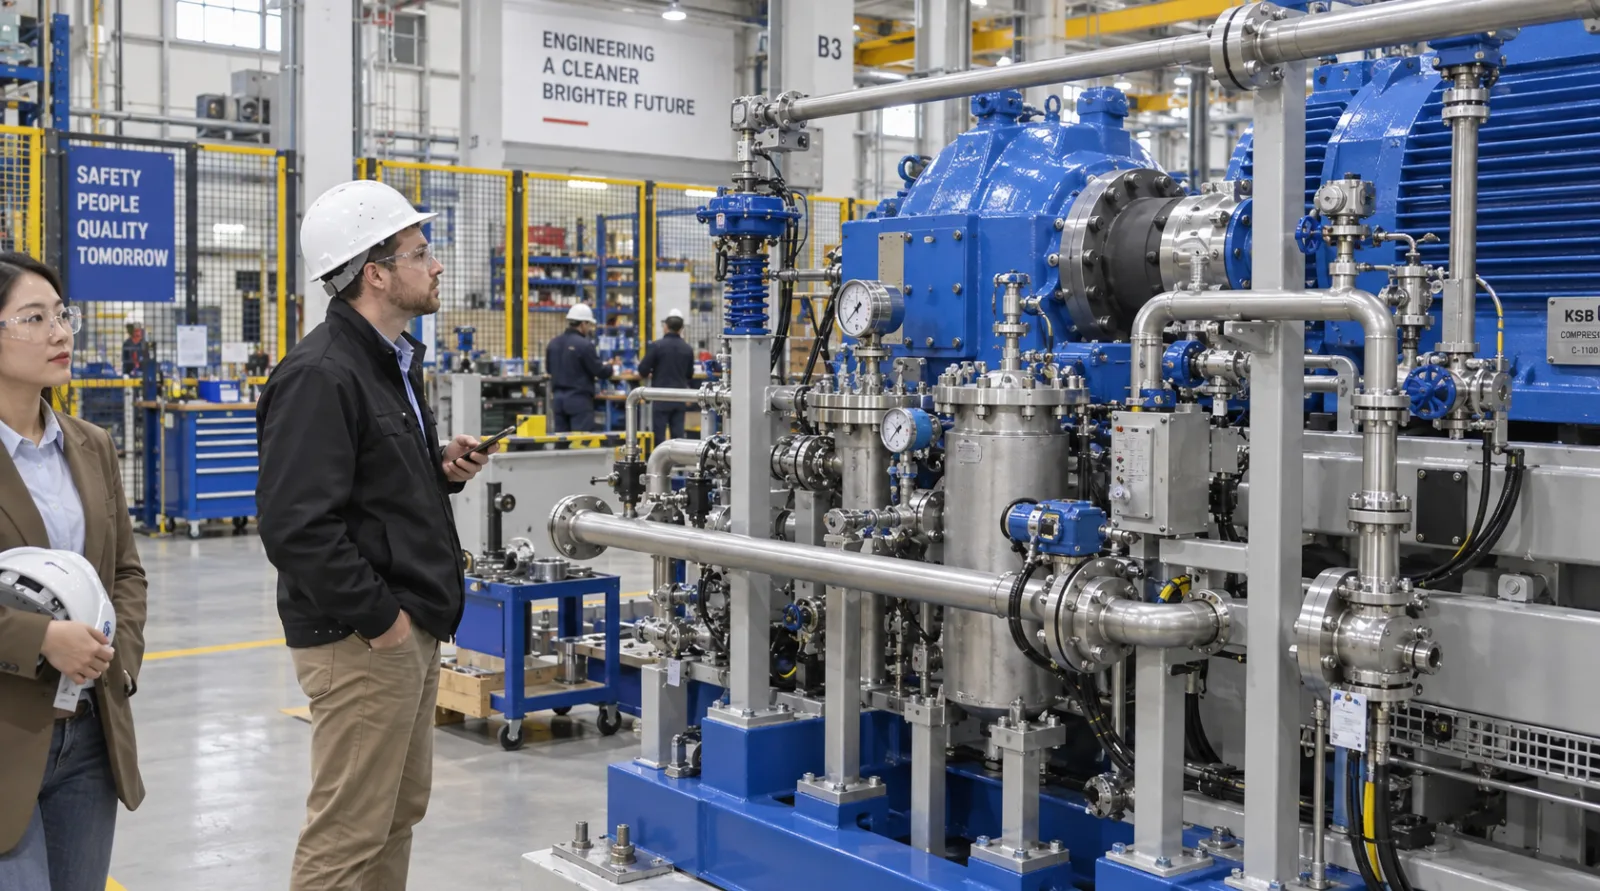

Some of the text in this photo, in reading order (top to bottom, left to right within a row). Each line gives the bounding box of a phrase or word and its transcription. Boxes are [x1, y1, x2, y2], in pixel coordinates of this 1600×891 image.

[543, 30, 655, 62] ENGINEERING
[818, 35, 842, 60] B3
[543, 57, 639, 85] A CLEANER
[543, 82, 696, 116] BRIGHTER FUTURE
[77, 165, 142, 188] SAFETY
[77, 192, 140, 213] PEOPLE
[77, 219, 149, 240] QUALITY
[77, 246, 169, 267] TOMORROW
[1565, 309, 1595, 323] KSB
